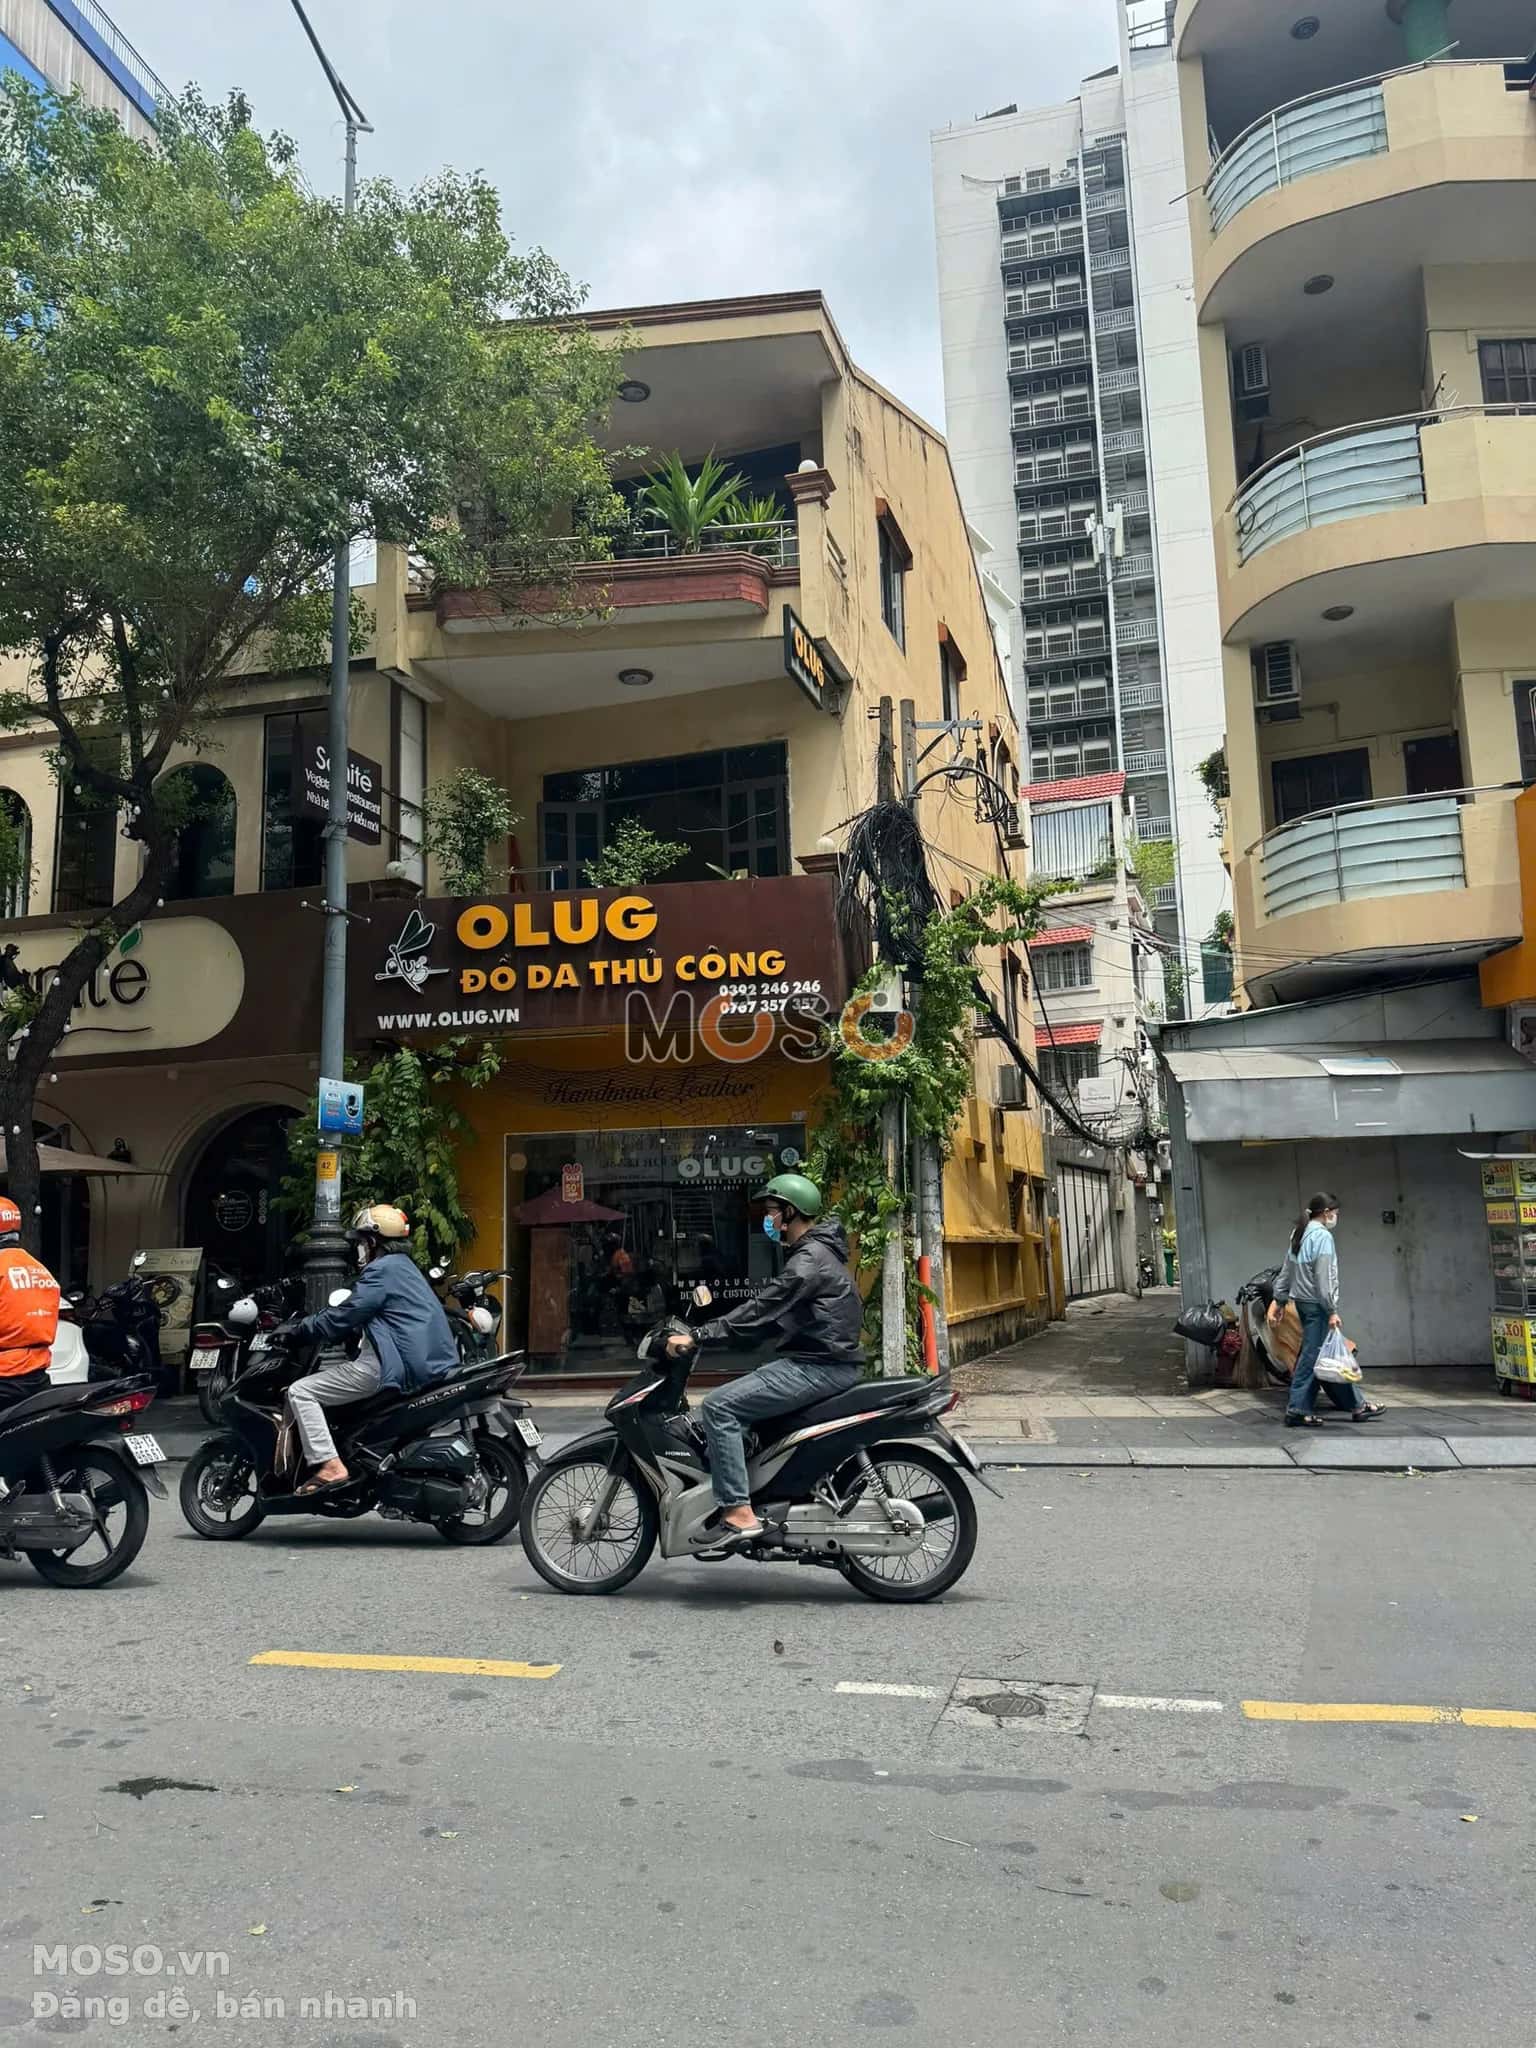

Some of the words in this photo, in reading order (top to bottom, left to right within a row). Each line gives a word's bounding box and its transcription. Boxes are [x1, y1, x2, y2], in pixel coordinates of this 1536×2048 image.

[794, 627, 824, 687] OLUG
[456, 896, 658, 950] OLUG
[460, 953, 517, 994] ĐỒ
[527, 965, 581, 989] DA
[589, 947, 663, 985] THỦ
[675, 945, 786, 981] CÔNG
[719, 983, 757, 997] 0392
[760, 981, 789, 995] 246
[792, 979, 821, 993] 246
[760, 998, 788, 1012] 357
[792, 997, 820, 1010] 357
[377, 1008, 520, 1031] WWW.OLUG.VN
[678, 1155, 765, 1178] OLUG
